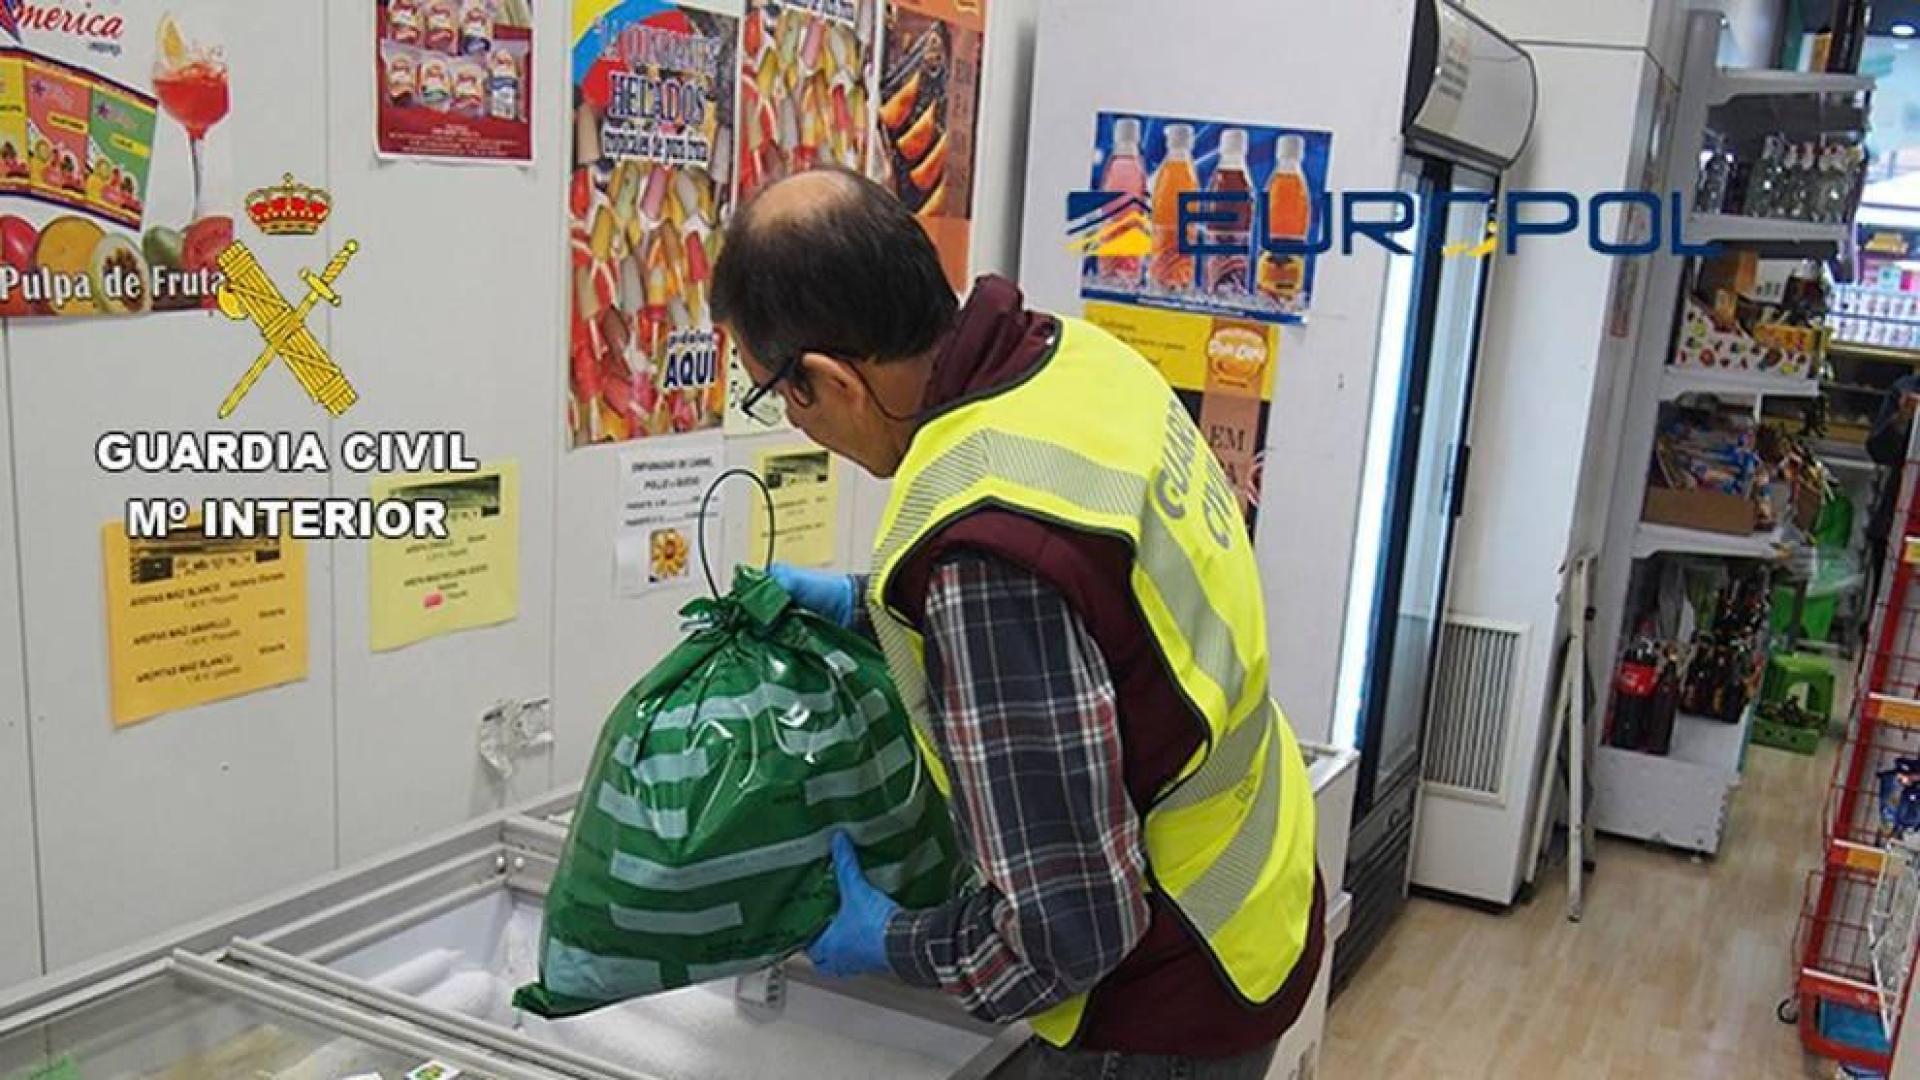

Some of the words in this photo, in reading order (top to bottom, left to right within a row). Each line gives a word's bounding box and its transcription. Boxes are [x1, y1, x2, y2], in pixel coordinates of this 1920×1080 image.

[13, 2, 123, 39] merica
[610, 73, 706, 124] HELADOS
[0, 266, 92, 309] Pulpa
[103, 266, 140, 297] de
[152, 264, 226, 298] Fruta
